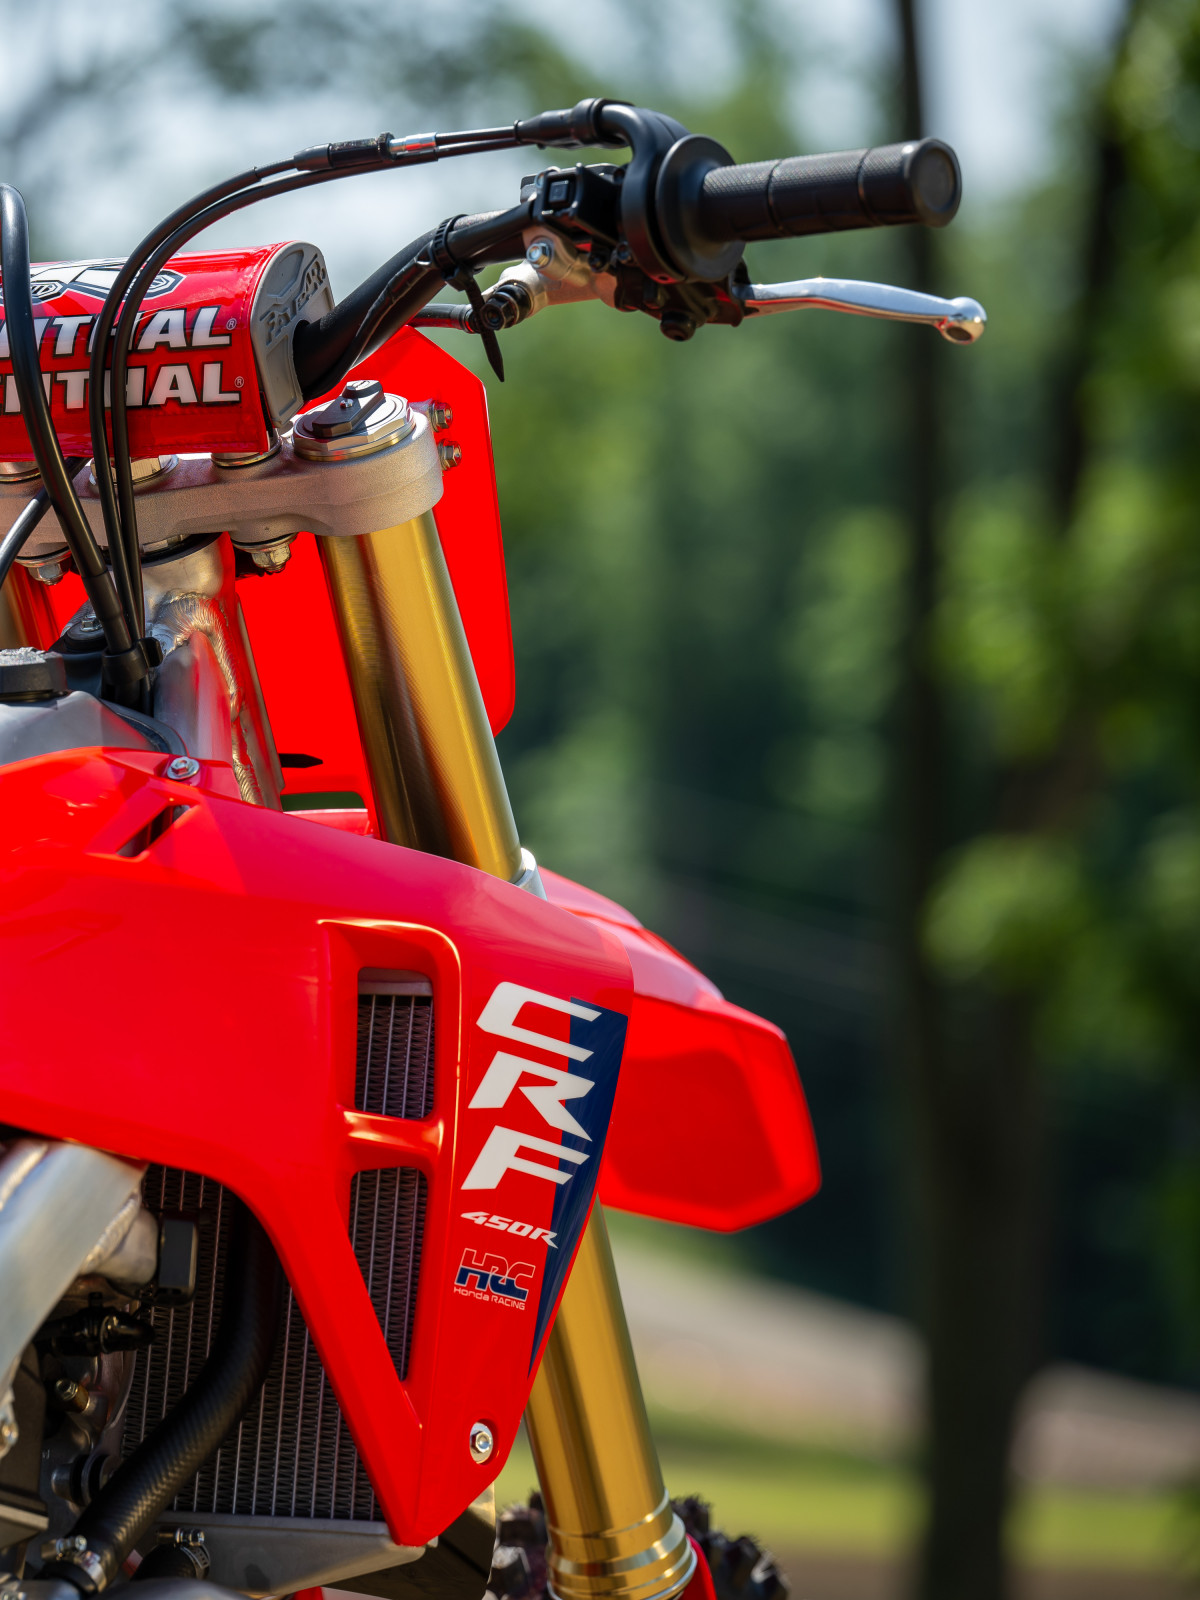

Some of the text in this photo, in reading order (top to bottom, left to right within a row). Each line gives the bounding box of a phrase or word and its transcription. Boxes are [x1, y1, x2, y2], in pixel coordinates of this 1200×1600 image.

[461, 981, 602, 1190] CRF
[460, 1211, 558, 1249] 450R
[453, 1286, 525, 1310] Honda RACING
[454, 1248, 536, 1302] HRC
